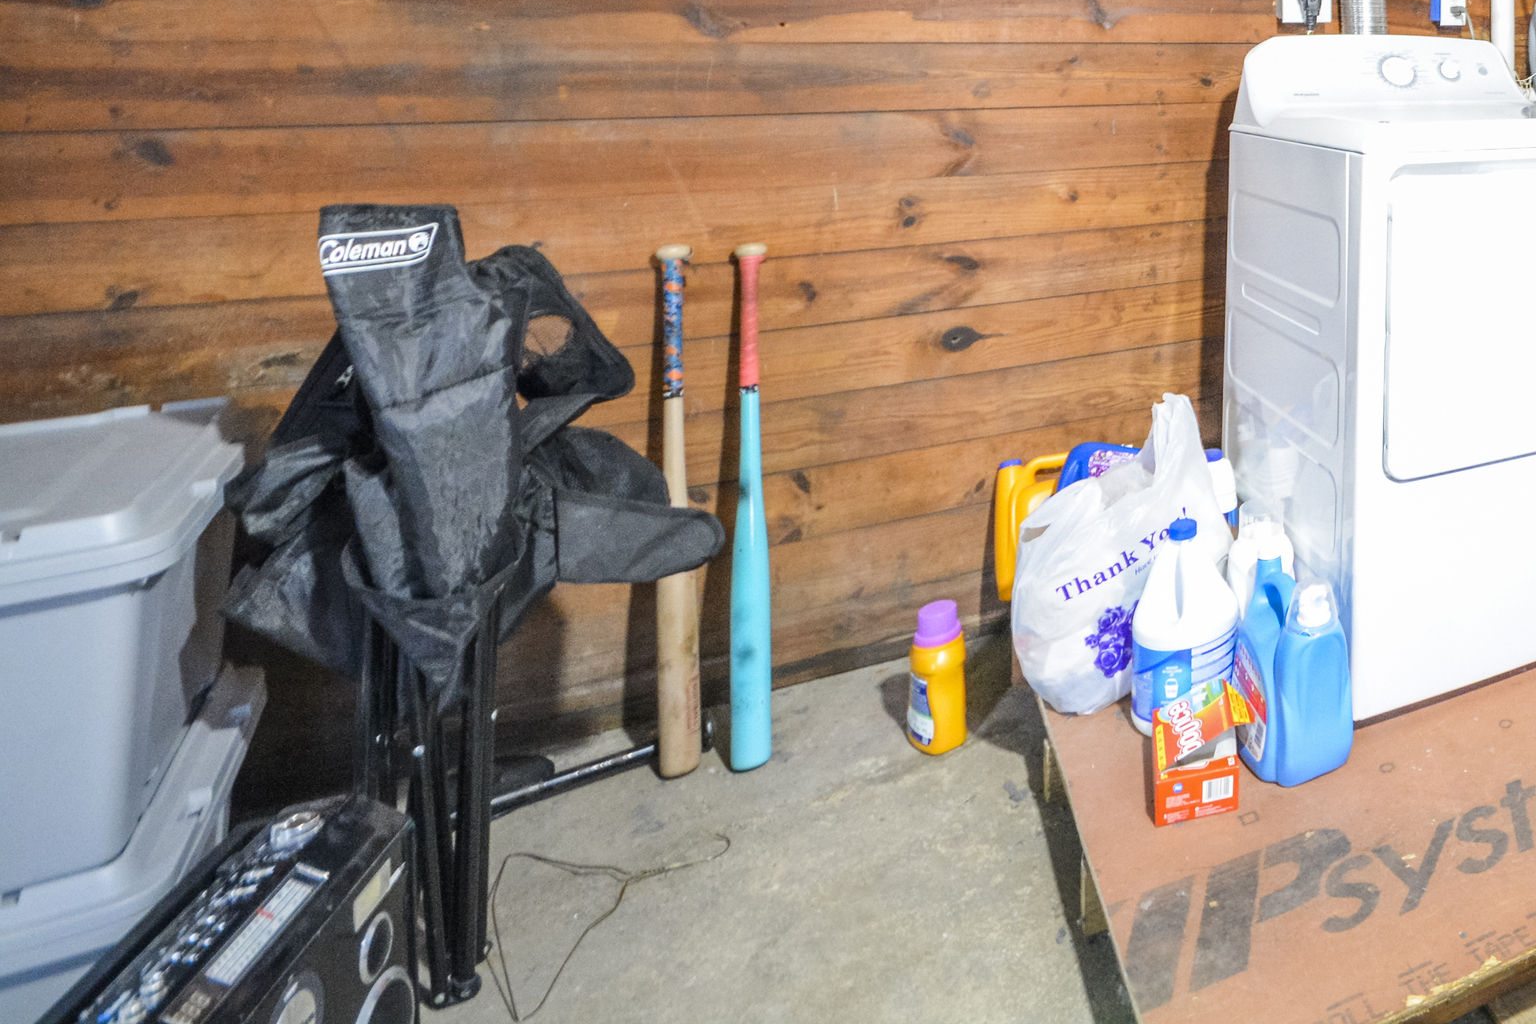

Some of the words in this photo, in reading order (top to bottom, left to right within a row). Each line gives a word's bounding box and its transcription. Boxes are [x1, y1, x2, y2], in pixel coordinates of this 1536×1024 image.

[319, 238, 408, 265] Coleman
[1055, 549, 1139, 602] Thank
[1140, 507, 1187, 553] Yo!
[1168, 700, 1206, 764] bounce
